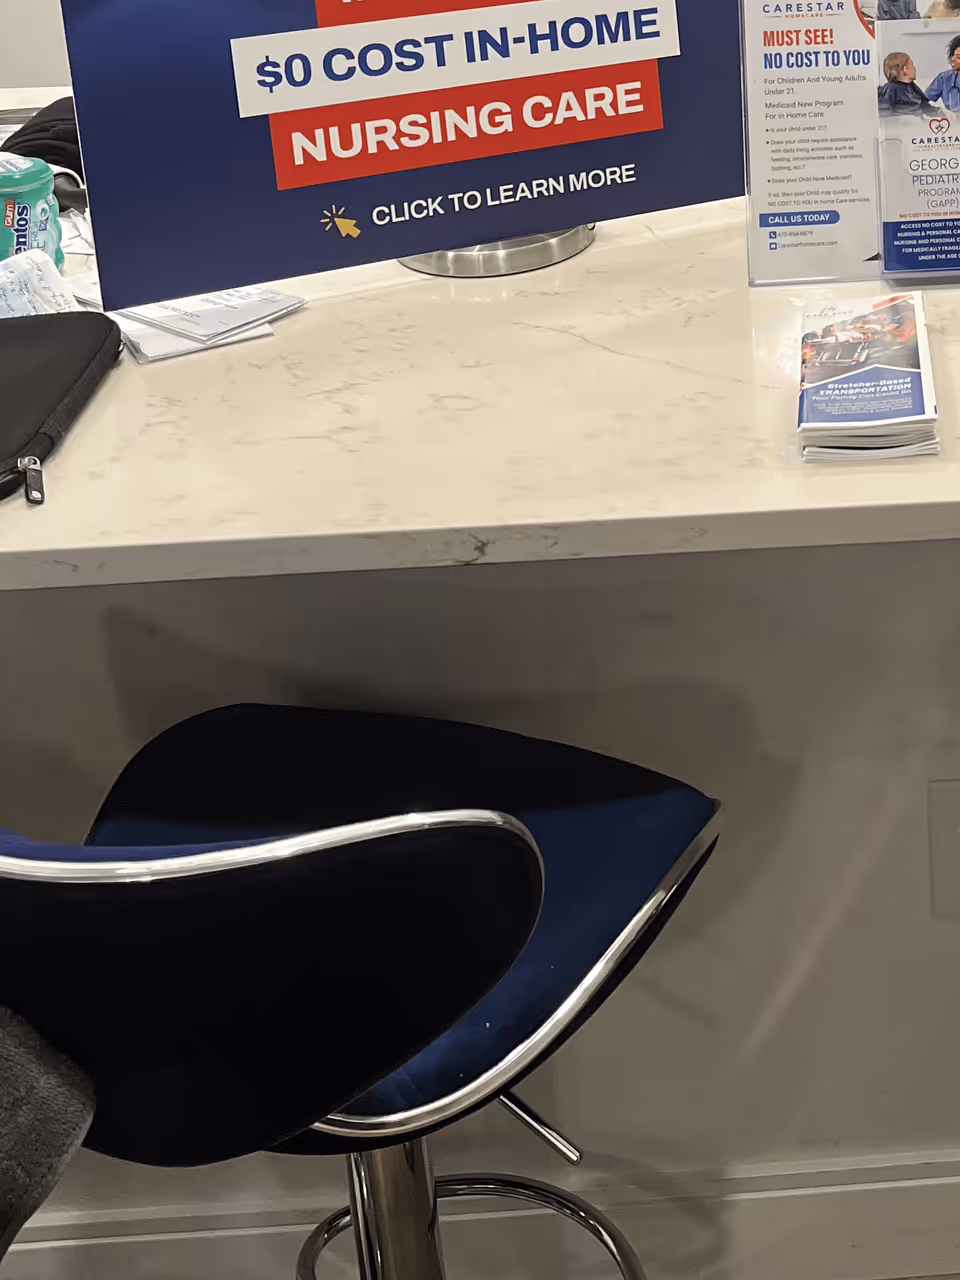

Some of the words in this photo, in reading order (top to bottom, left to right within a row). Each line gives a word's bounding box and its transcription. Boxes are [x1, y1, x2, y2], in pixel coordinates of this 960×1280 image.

[762, 2, 845, 14] CARESTAR
[763, 30, 801, 47] MUST
[804, 28, 834, 45] SEE!
[256, 52, 312, 94] $0
[322, 33, 453, 82] COST
[463, 6, 661, 64] IN-HOME
[763, 52, 783, 69] NO
[786, 51, 820, 68] COST
[823, 50, 841, 67] TO
[843, 49, 871, 66] YOU
[821, 75, 843, 84] Young
[844, 73, 866, 81] Adults
[764, 88, 785, 96] Under
[765, 101, 797, 109] Medicaid
[797, 100, 813, 108] New
[814, 99, 844, 109] Program
[765, 112, 777, 120] For
[786, 111, 807, 119] Home
[291, 101, 513, 167] NURSING
[522, 80, 644, 128] CARE
[371, 195, 445, 226] CLICK
[448, 190, 482, 212] TO
[485, 174, 565, 206] LEARN
[568, 163, 637, 193] MORE
[926, 197, 960, 210] (GAPP)
[768, 215, 789, 224] CALL
[790, 214, 802, 223] US
[803, 213, 830, 222] TODAY
[15, 203, 31, 256] entos
[819, 383, 912, 396] TRANSPORTATION
